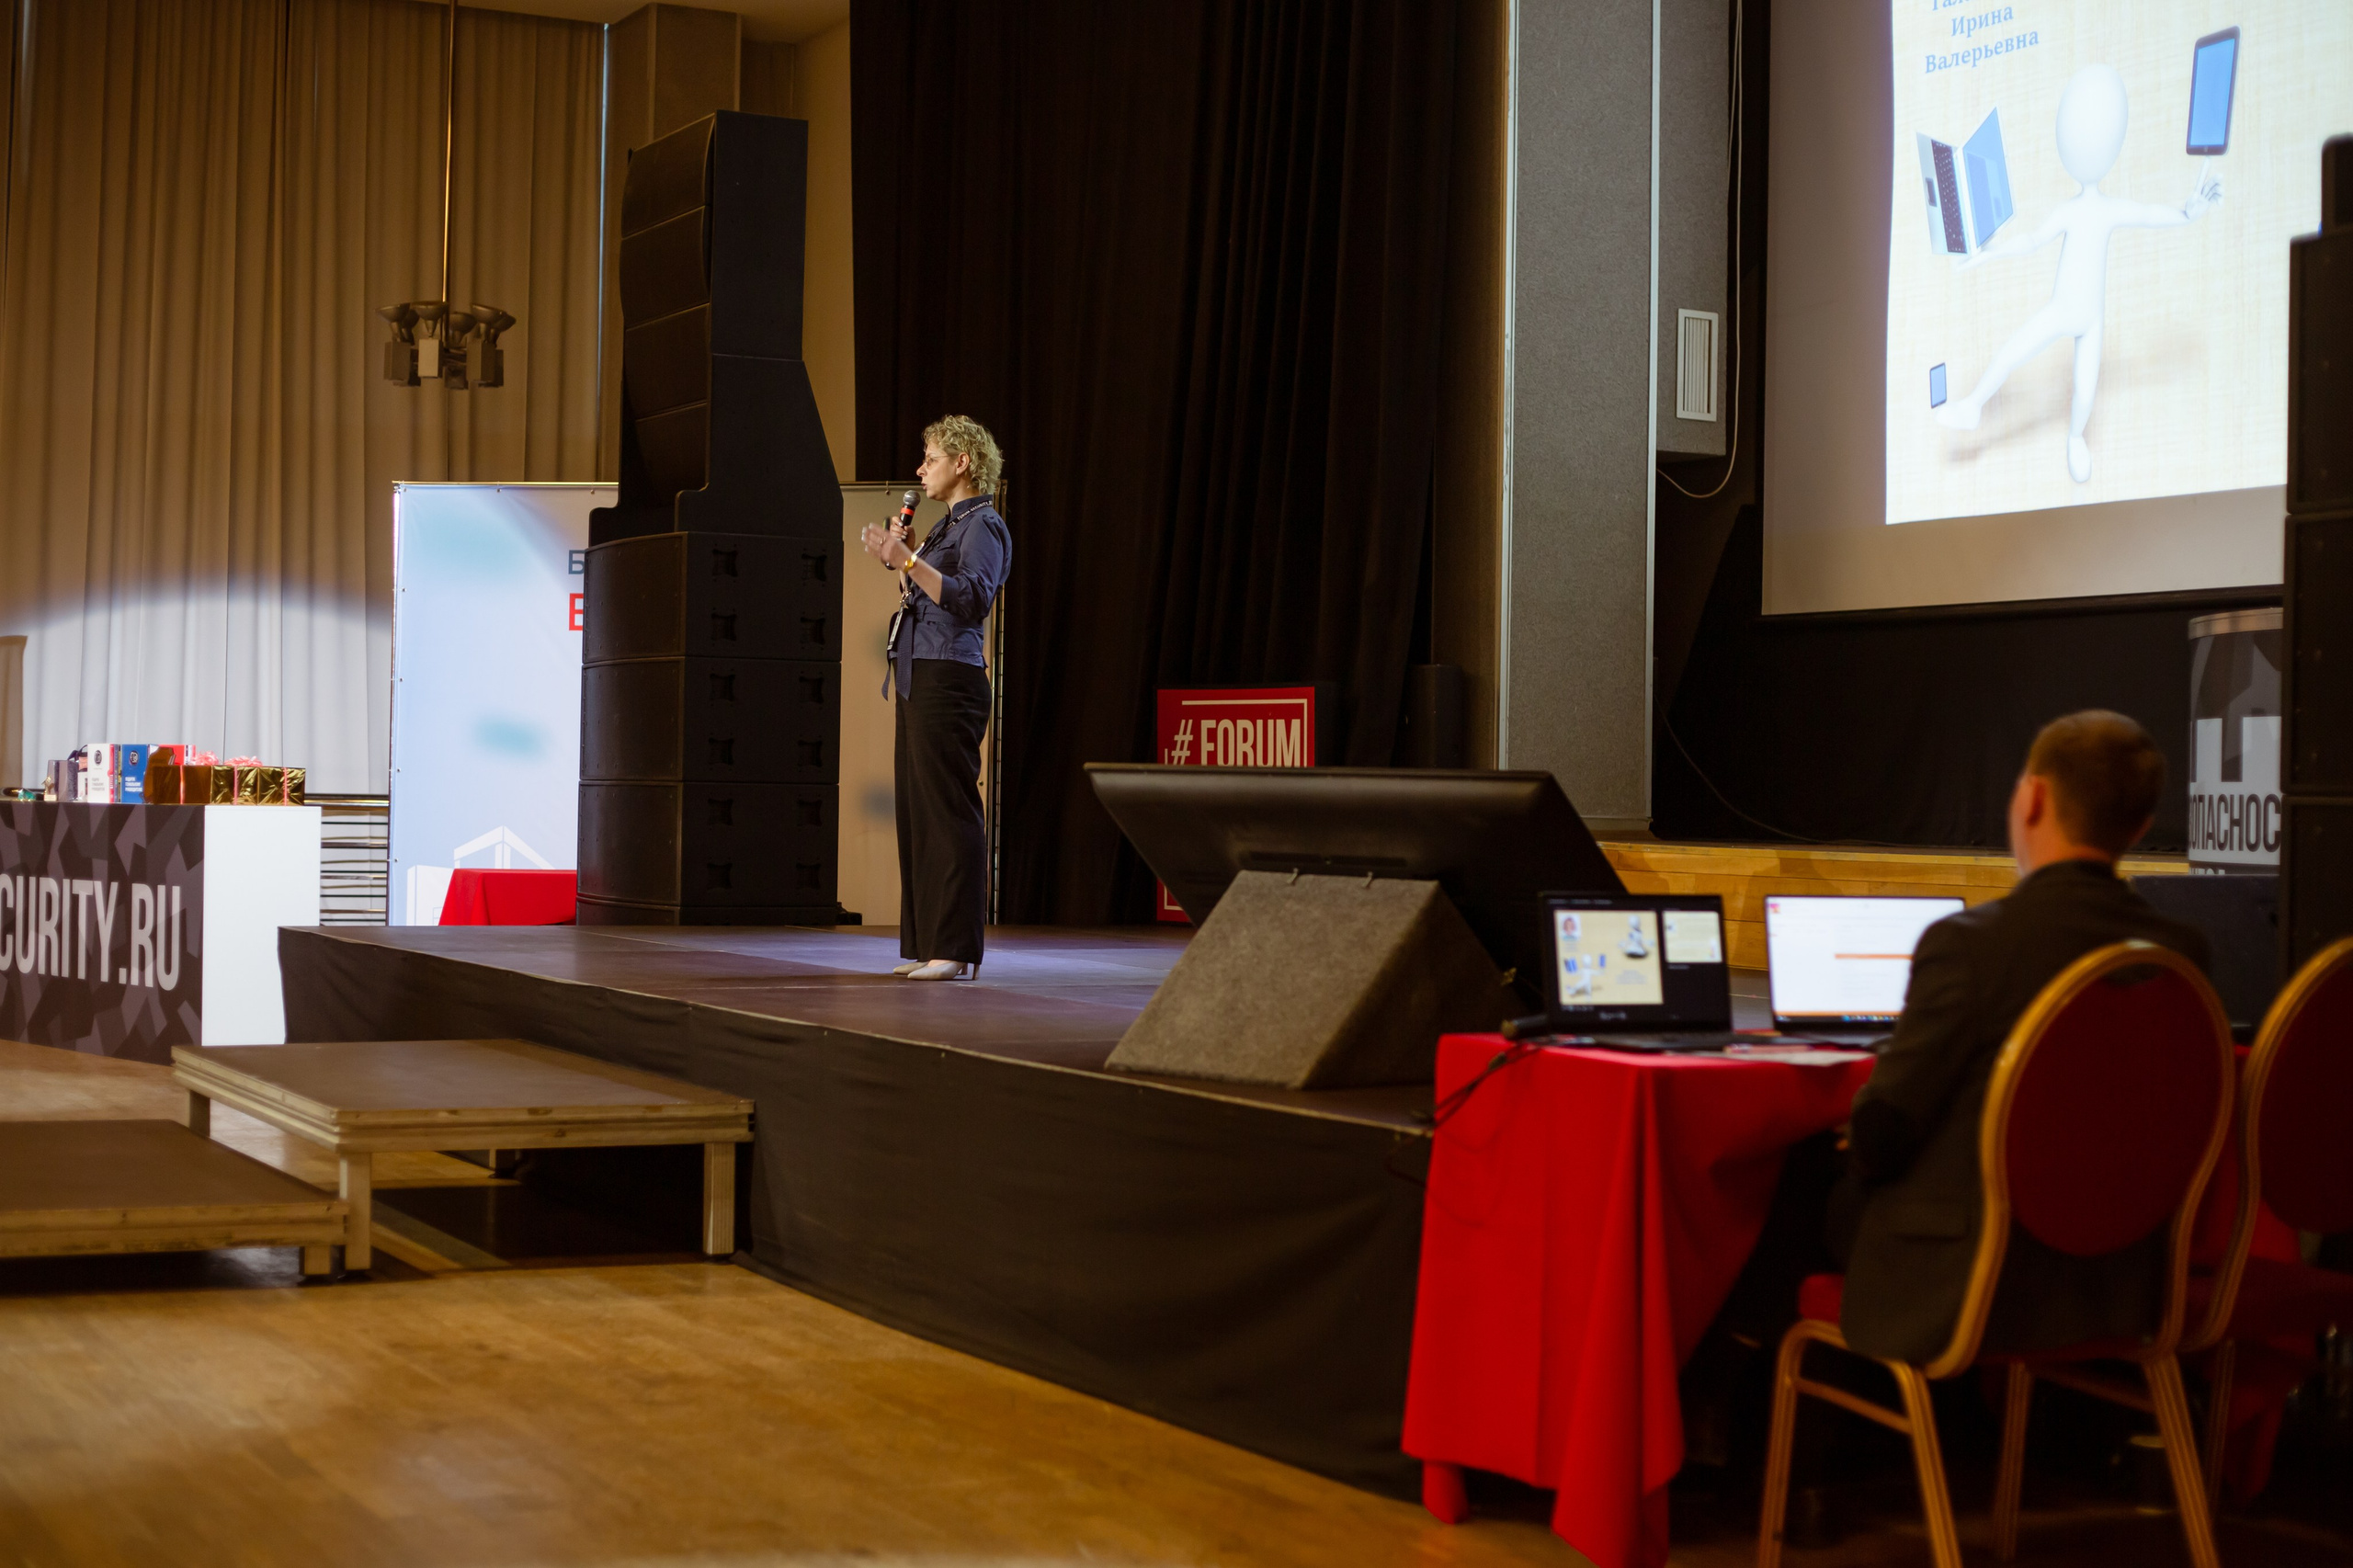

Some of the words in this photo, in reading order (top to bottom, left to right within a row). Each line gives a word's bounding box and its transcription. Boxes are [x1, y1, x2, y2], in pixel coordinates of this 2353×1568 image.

[1950, 6, 2014, 38] Ирина
[1925, 30, 2040, 74] Валерьевна
[1200, 719, 1301, 767] FORUM
[2188, 793, 2281, 853] ОПАСНОС
[0, 874, 181, 992] CURITY.RU
